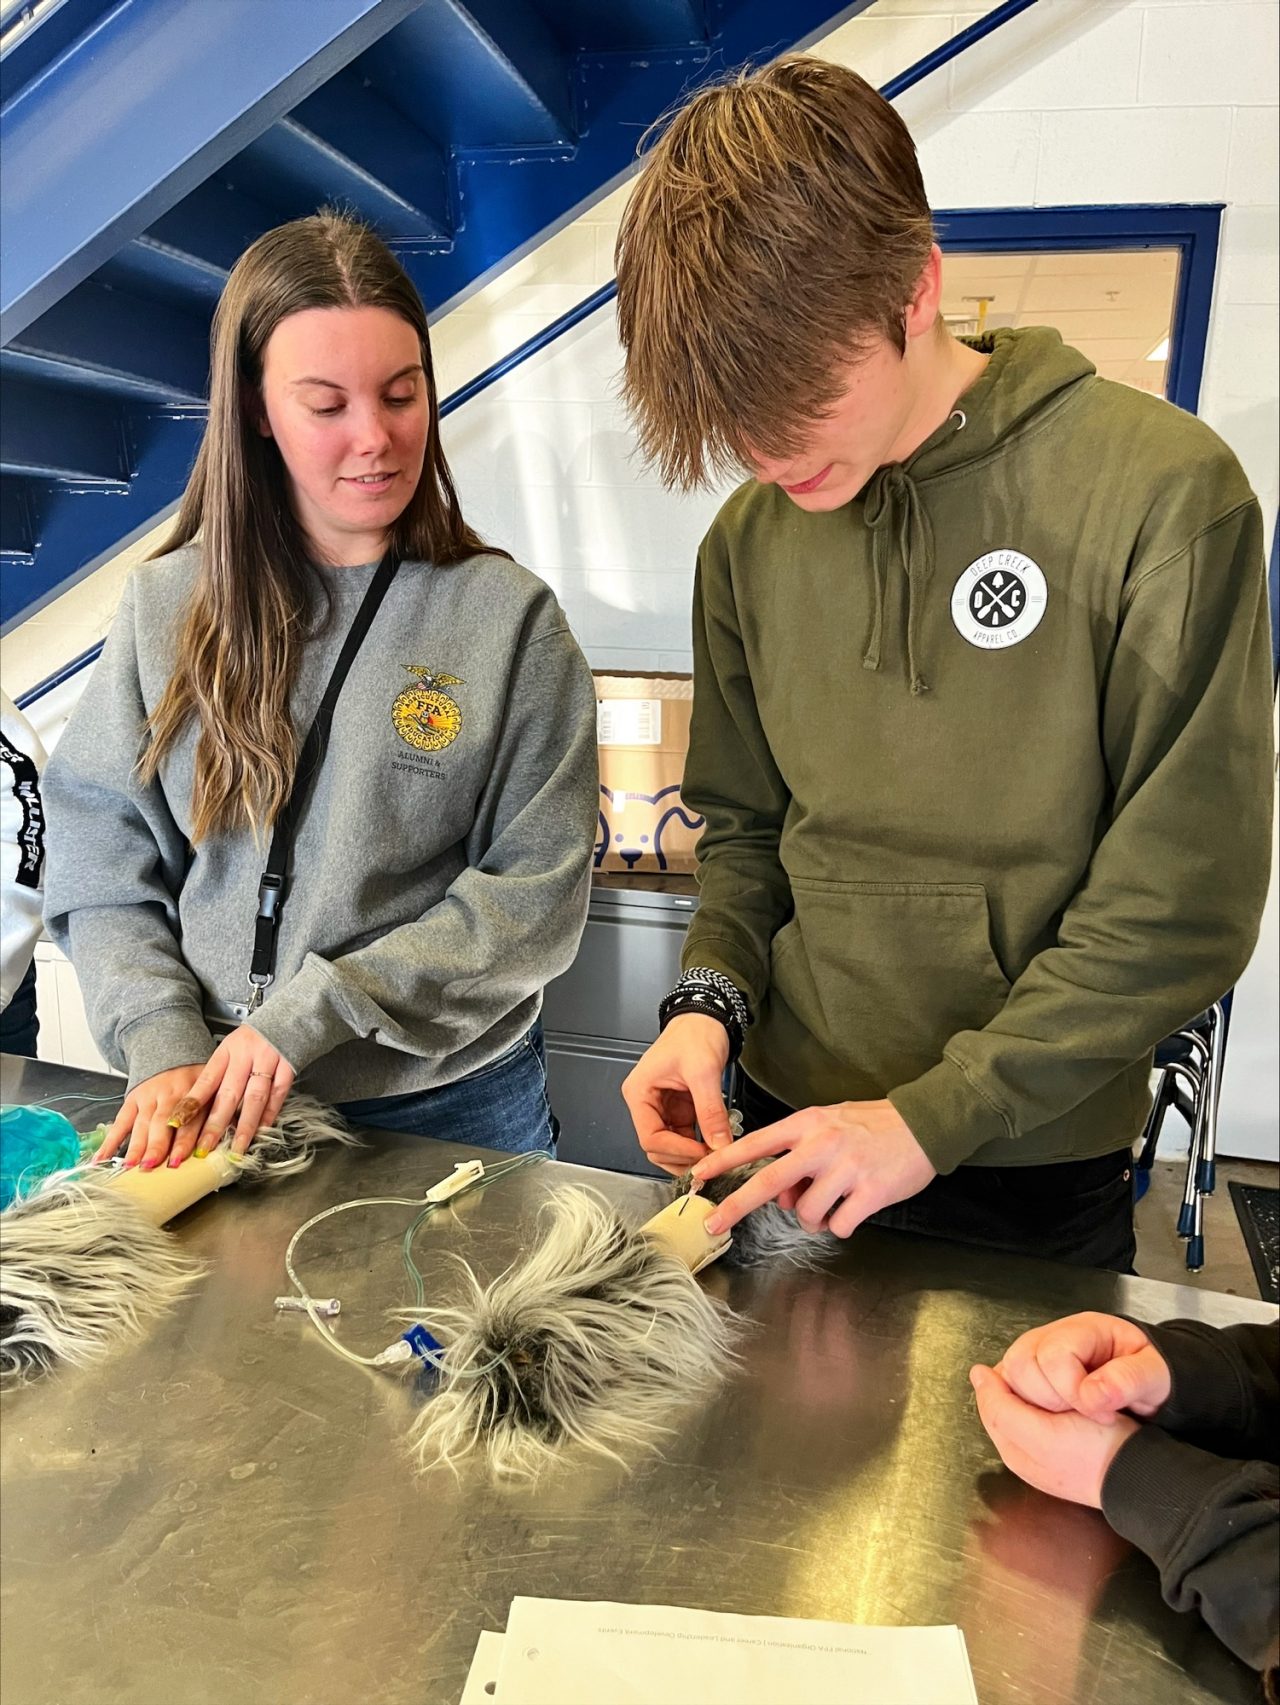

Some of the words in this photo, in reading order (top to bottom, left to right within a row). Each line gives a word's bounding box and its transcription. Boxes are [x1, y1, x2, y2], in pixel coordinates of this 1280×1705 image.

[970, 556, 994, 576] DEEP
[998, 554, 1032, 574] CREEK
[973, 631, 1004, 644] APPAREL
[405, 694, 450, 719] AGRICULTURAL
[416, 701, 441, 716] FFA
[397, 751, 434, 767] ALUMNI
[391, 762, 446, 780] SUPPORTERS
